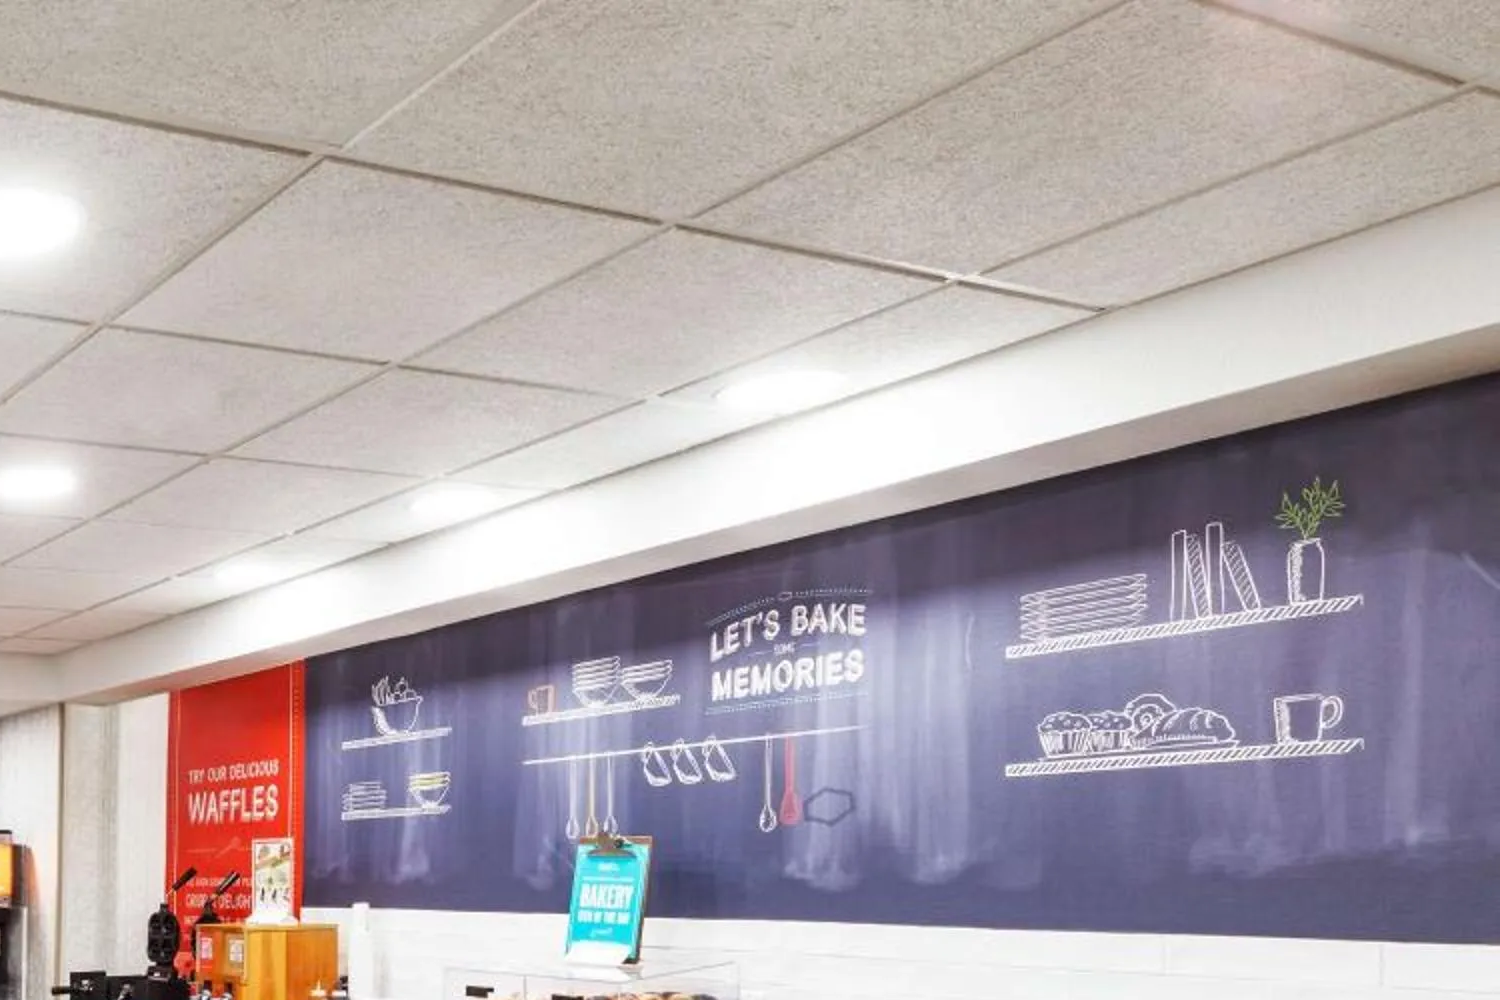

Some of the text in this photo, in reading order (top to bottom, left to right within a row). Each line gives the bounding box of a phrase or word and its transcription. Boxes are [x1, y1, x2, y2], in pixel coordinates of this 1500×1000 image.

[710, 602, 868, 663] LET'S BAKE
[710, 648, 865, 703] MEMORIES
[188, 758, 279, 785] TRY OUR DELICIOUS
[188, 783, 279, 827] WAFFLES
[579, 883, 635, 909] BAKERY
